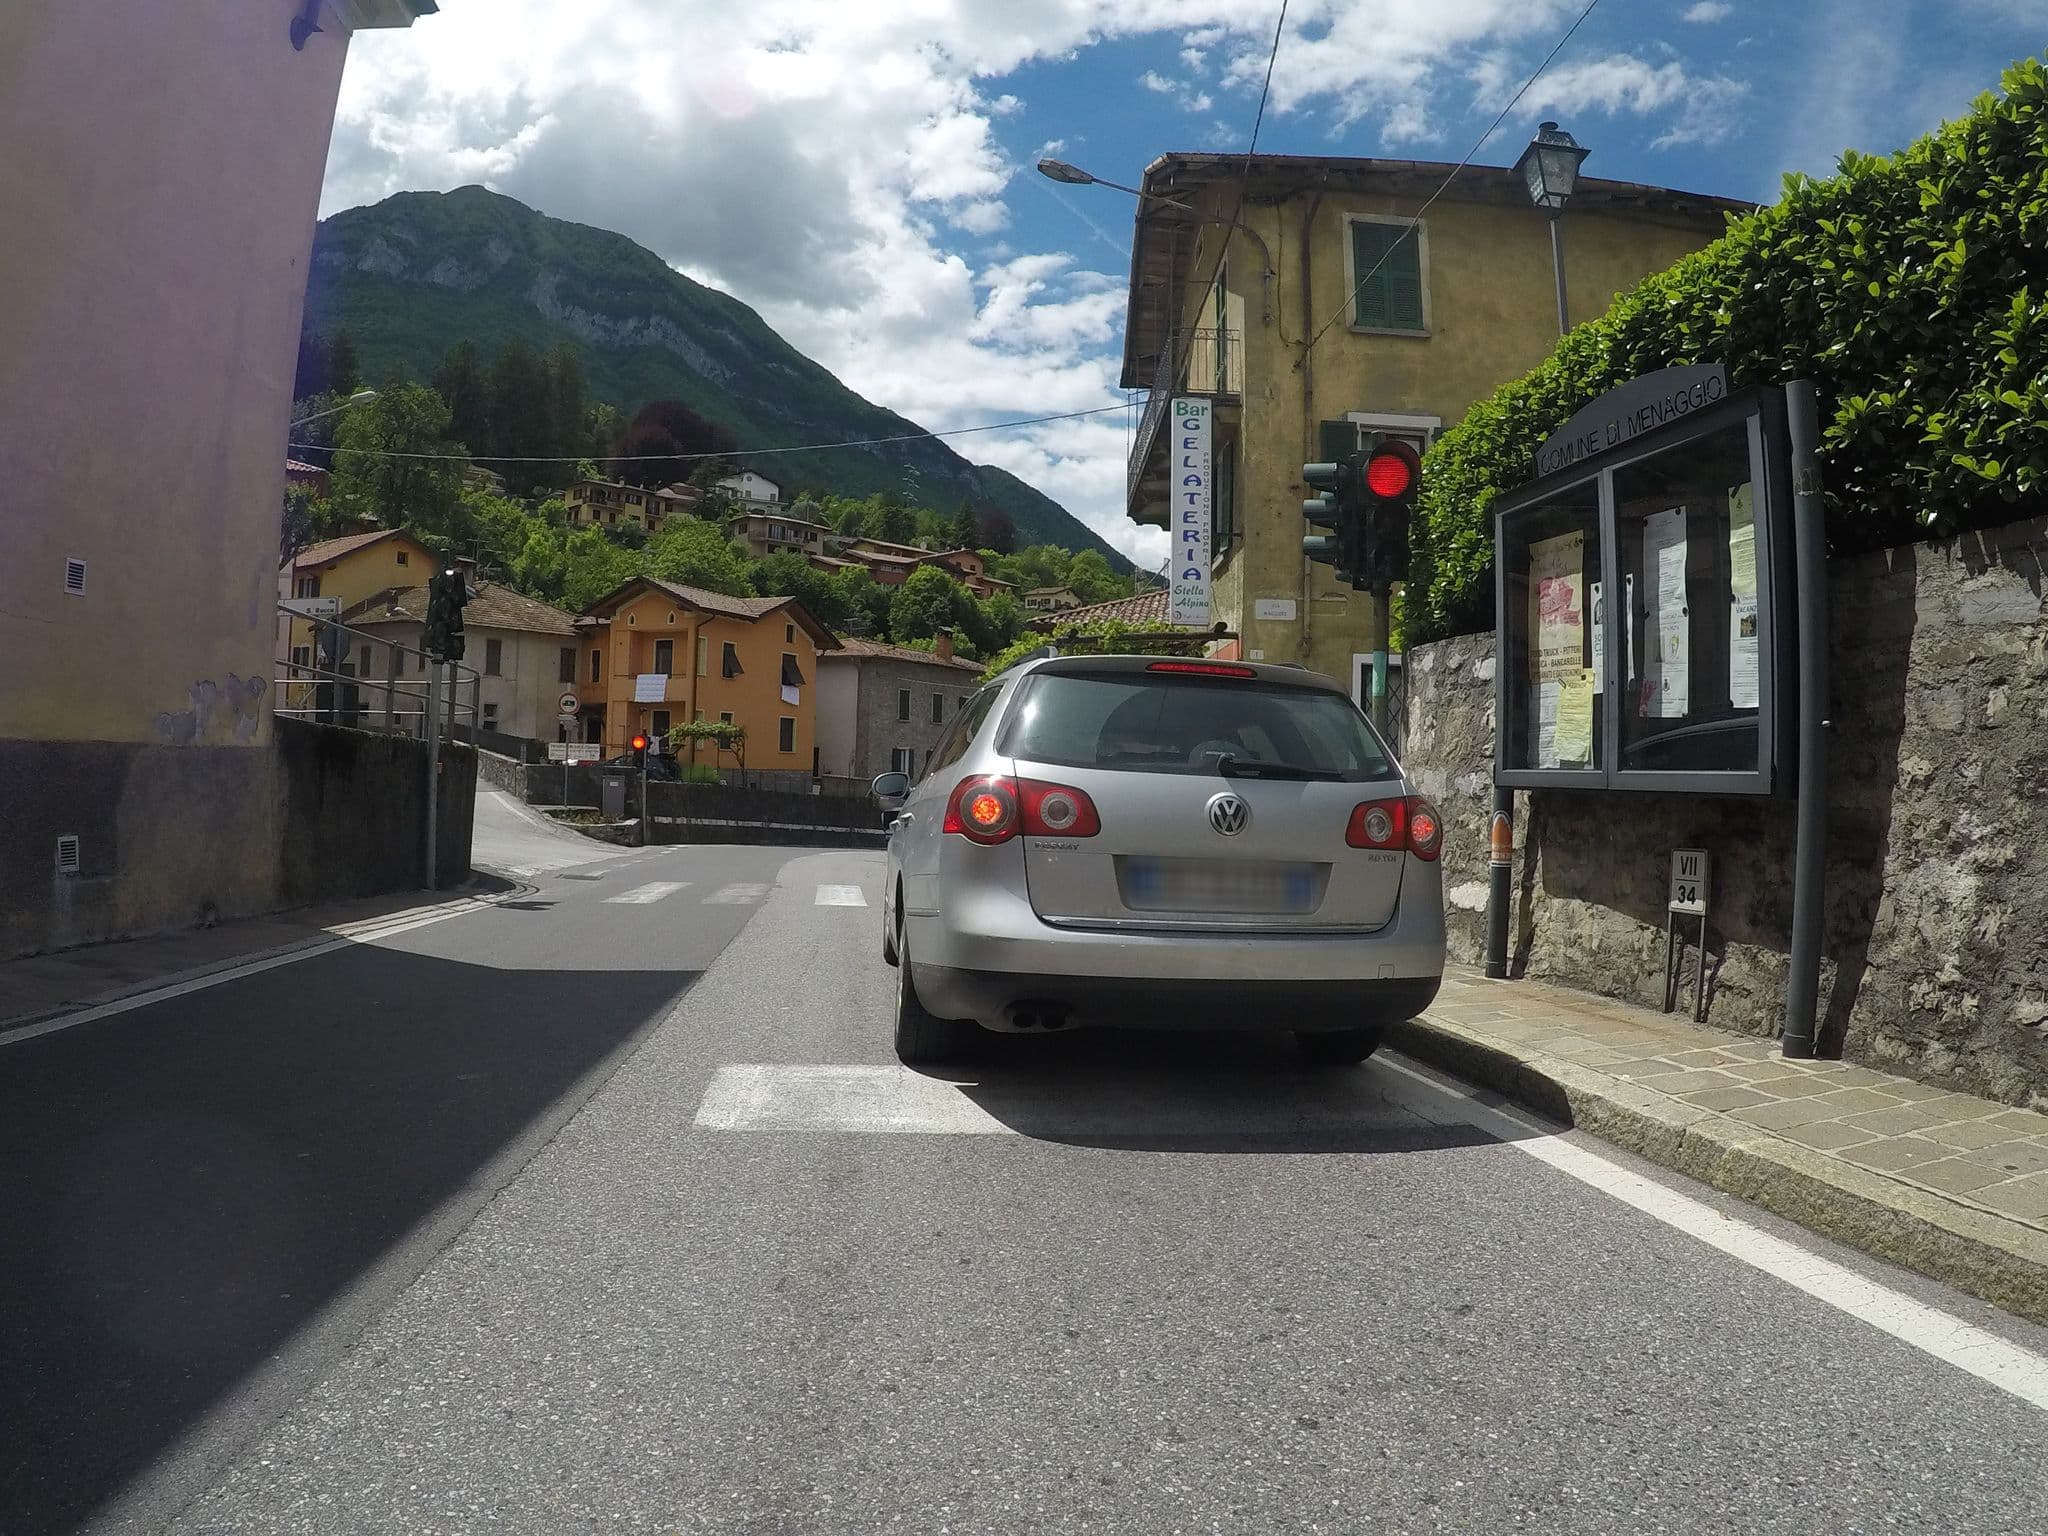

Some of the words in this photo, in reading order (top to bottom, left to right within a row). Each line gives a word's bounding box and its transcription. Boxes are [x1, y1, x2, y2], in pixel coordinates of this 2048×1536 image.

[1176, 401, 1208, 416] Bar
[1541, 430, 1599, 473] COMUNE
[1607, 422, 1620, 446] DI
[1629, 375, 1721, 437] MENAGGIO
[1182, 418, 1202, 581] GELATERIA
[1174, 584, 1204, 596] Stella
[1680, 855, 1698, 876] VII
[1678, 885, 1696, 905] 34
